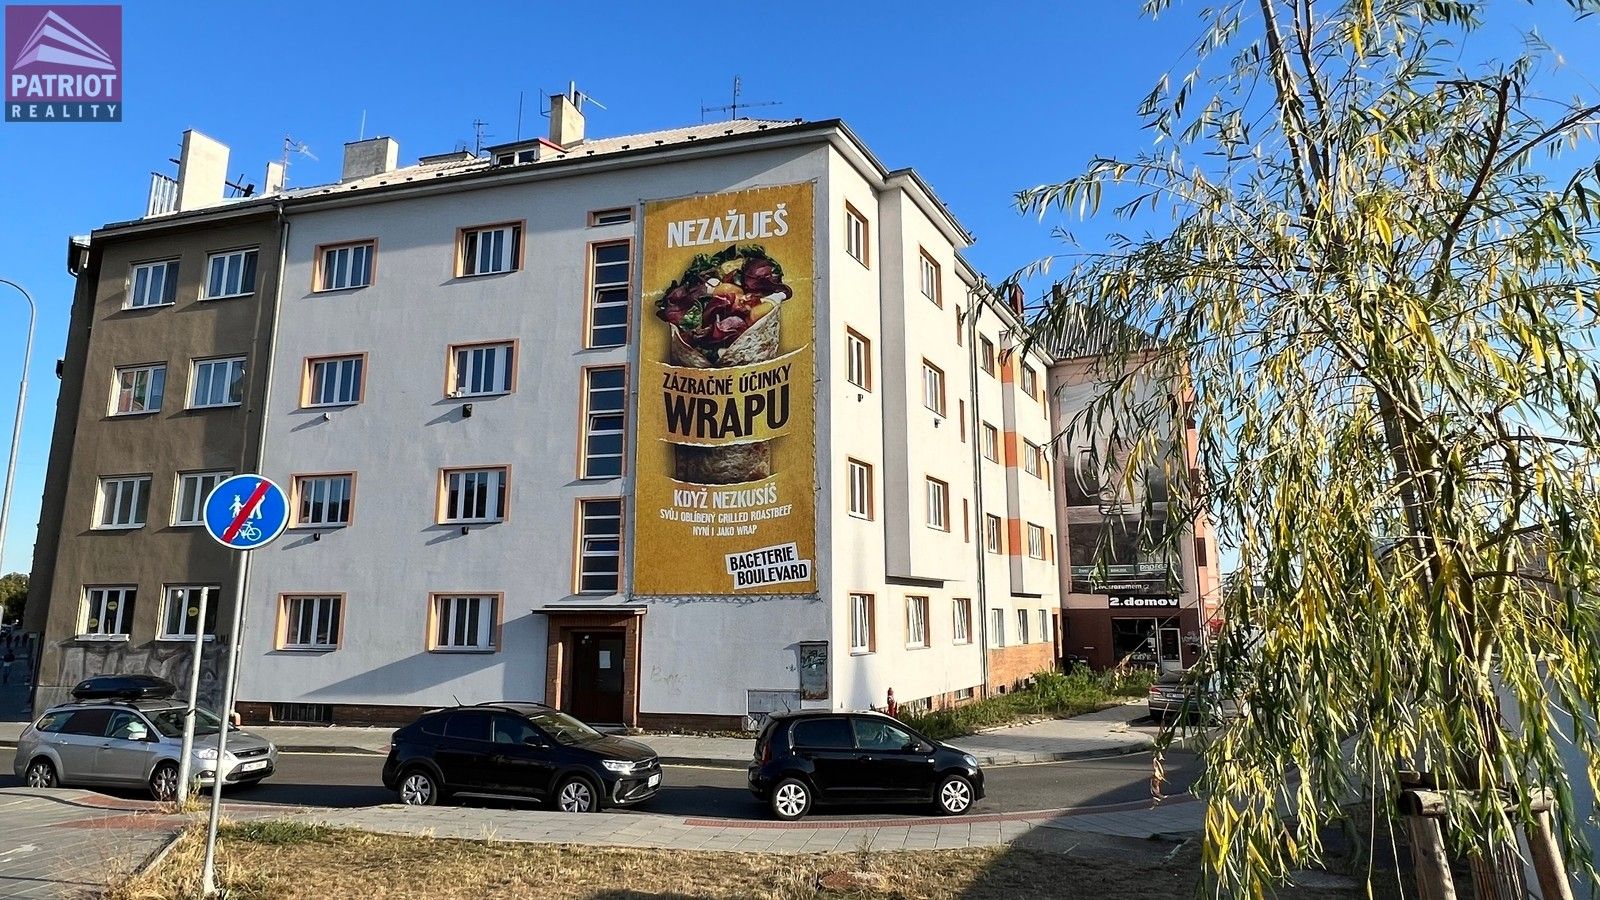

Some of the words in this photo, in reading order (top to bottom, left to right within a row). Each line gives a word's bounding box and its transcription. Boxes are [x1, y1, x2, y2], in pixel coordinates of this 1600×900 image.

[667, 203, 789, 248] NEZAŽIJEŠ
[663, 371, 733, 395] ZÁZRAČNÉ
[739, 363, 792, 393] ÚČINKY
[664, 383, 790, 439] WRAPU
[674, 488, 708, 509] KDYŽ
[712, 482, 777, 509] NEZKUSÍŠ
[660, 507, 679, 521] SVŮJ
[680, 511, 715, 524] OBLÍBENÝ
[718, 511, 748, 524] GRILLED
[750, 504, 792, 521] ROASTBEEF
[692, 525, 710, 536] NYNÍ
[716, 526, 734, 536] JAKO
[736, 525, 757, 536] WRAP
[730, 546, 795, 572] BAGETERIE
[737, 563, 808, 586] BOULEVARD
[1109, 597, 1178, 606] 2.domov
